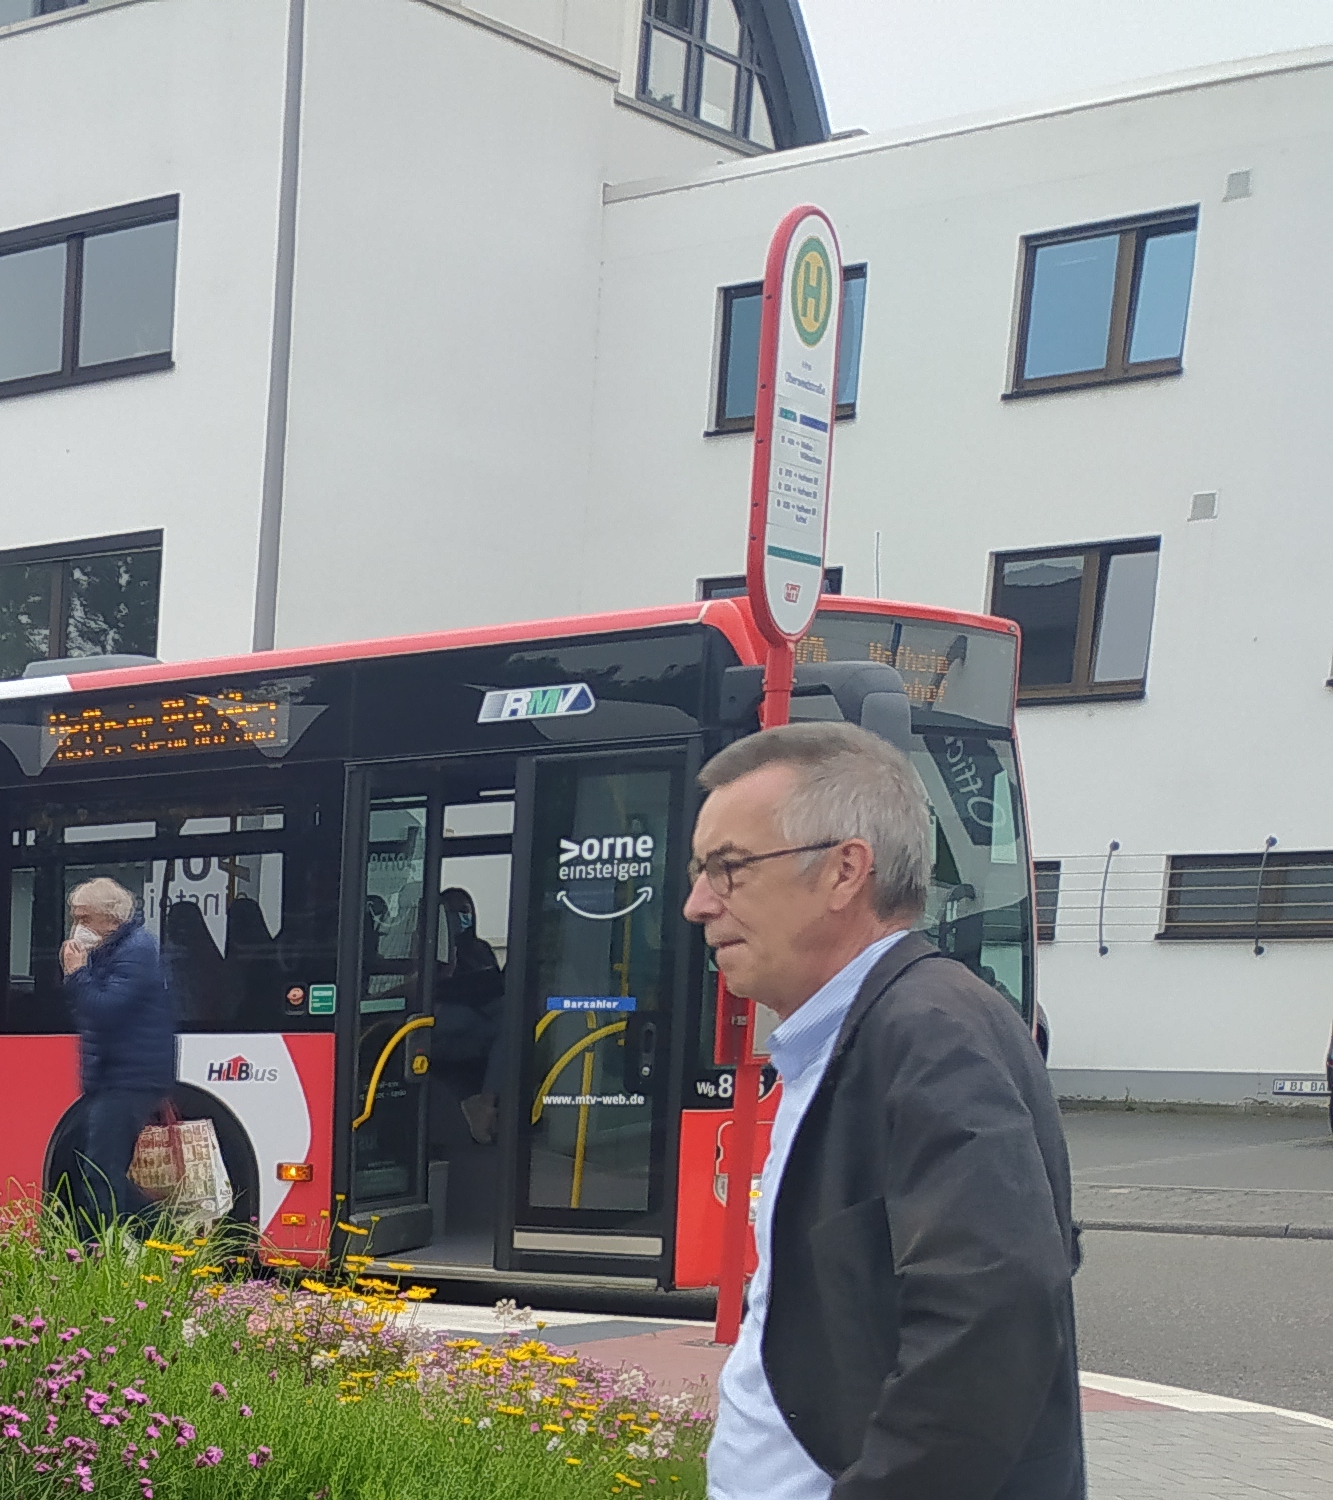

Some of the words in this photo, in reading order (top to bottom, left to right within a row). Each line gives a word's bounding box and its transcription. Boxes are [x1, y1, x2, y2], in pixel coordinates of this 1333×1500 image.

[501, 685, 584, 718] RMV
[559, 860, 651, 881] einsteigen
[563, 999, 620, 1010] Barzahler
[542, 1093, 646, 1106] www.mtv-web.de
